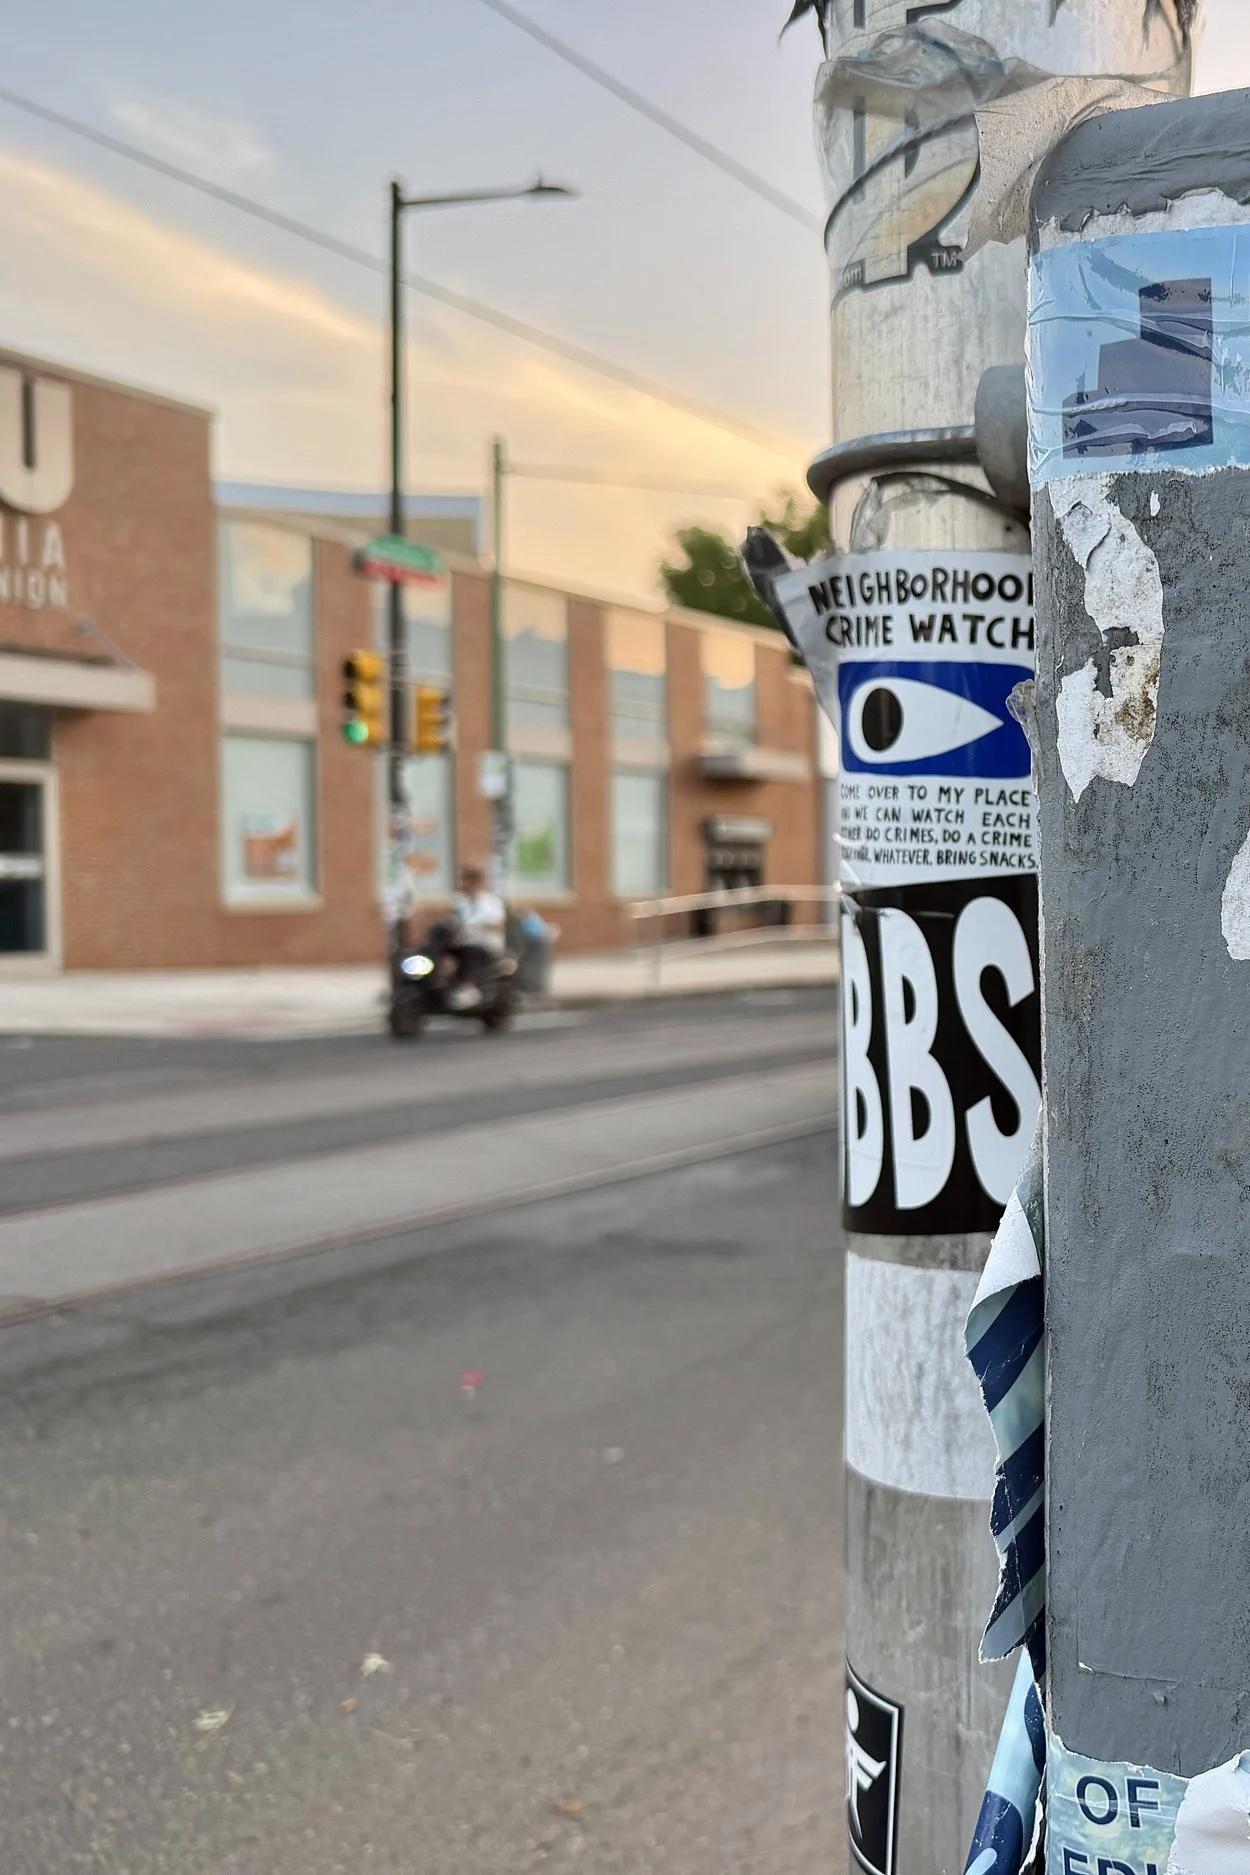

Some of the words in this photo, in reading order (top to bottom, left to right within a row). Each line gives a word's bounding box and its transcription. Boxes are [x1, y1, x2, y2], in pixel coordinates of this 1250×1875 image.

[825, 615, 894, 648] CRIME
[909, 613, 1035, 651] WATCH
[868, 785, 900, 801] OVER
[907, 785, 928, 801] TO
[938, 786, 965, 804] MY
[974, 787, 1032, 807] PLACE
[854, 806, 869, 821] WE
[876, 807, 901, 823] CAN
[911, 807, 964, 824] WATCH
[982, 811, 1030, 830] EACH
[865, 826, 881, 842] DO
[885, 827, 938, 845] CRIMES,
[943, 828, 961, 844] DO
[966, 831, 976, 845] A
[981, 830, 1032, 848] CRIME
[937, 848, 977, 866] BRING
[979, 850, 1038, 870] SNACKS.
[841, 896, 1043, 1210] BBS
[1075, 1774, 1161, 1829] OF
